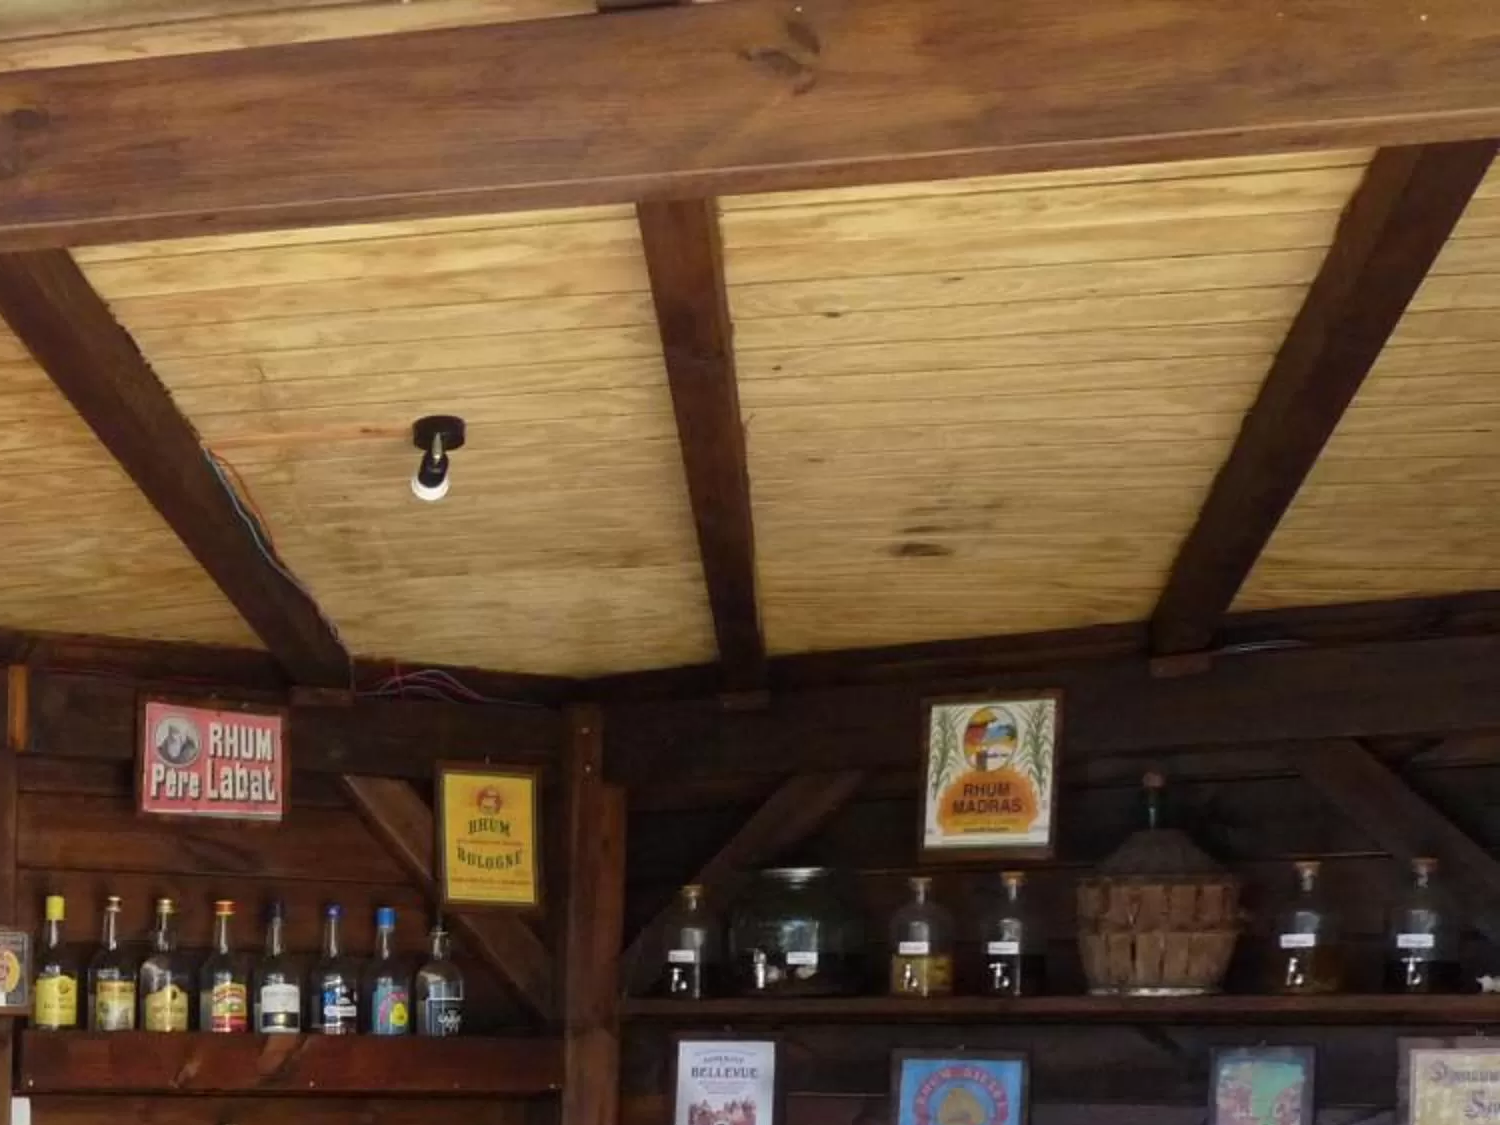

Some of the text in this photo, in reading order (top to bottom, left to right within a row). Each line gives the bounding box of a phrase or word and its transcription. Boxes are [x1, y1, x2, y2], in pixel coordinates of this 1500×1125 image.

[208, 721, 274, 762] RHUM
[206, 759, 277, 802] Labat
[963, 782, 1011, 797] RHUM
[952, 798, 1023, 814] MADRAS
[467, 818, 511, 838] RHUM
[457, 847, 524, 871] BOLOGNE
[691, 1066, 758, 1079] BELLEVUE
